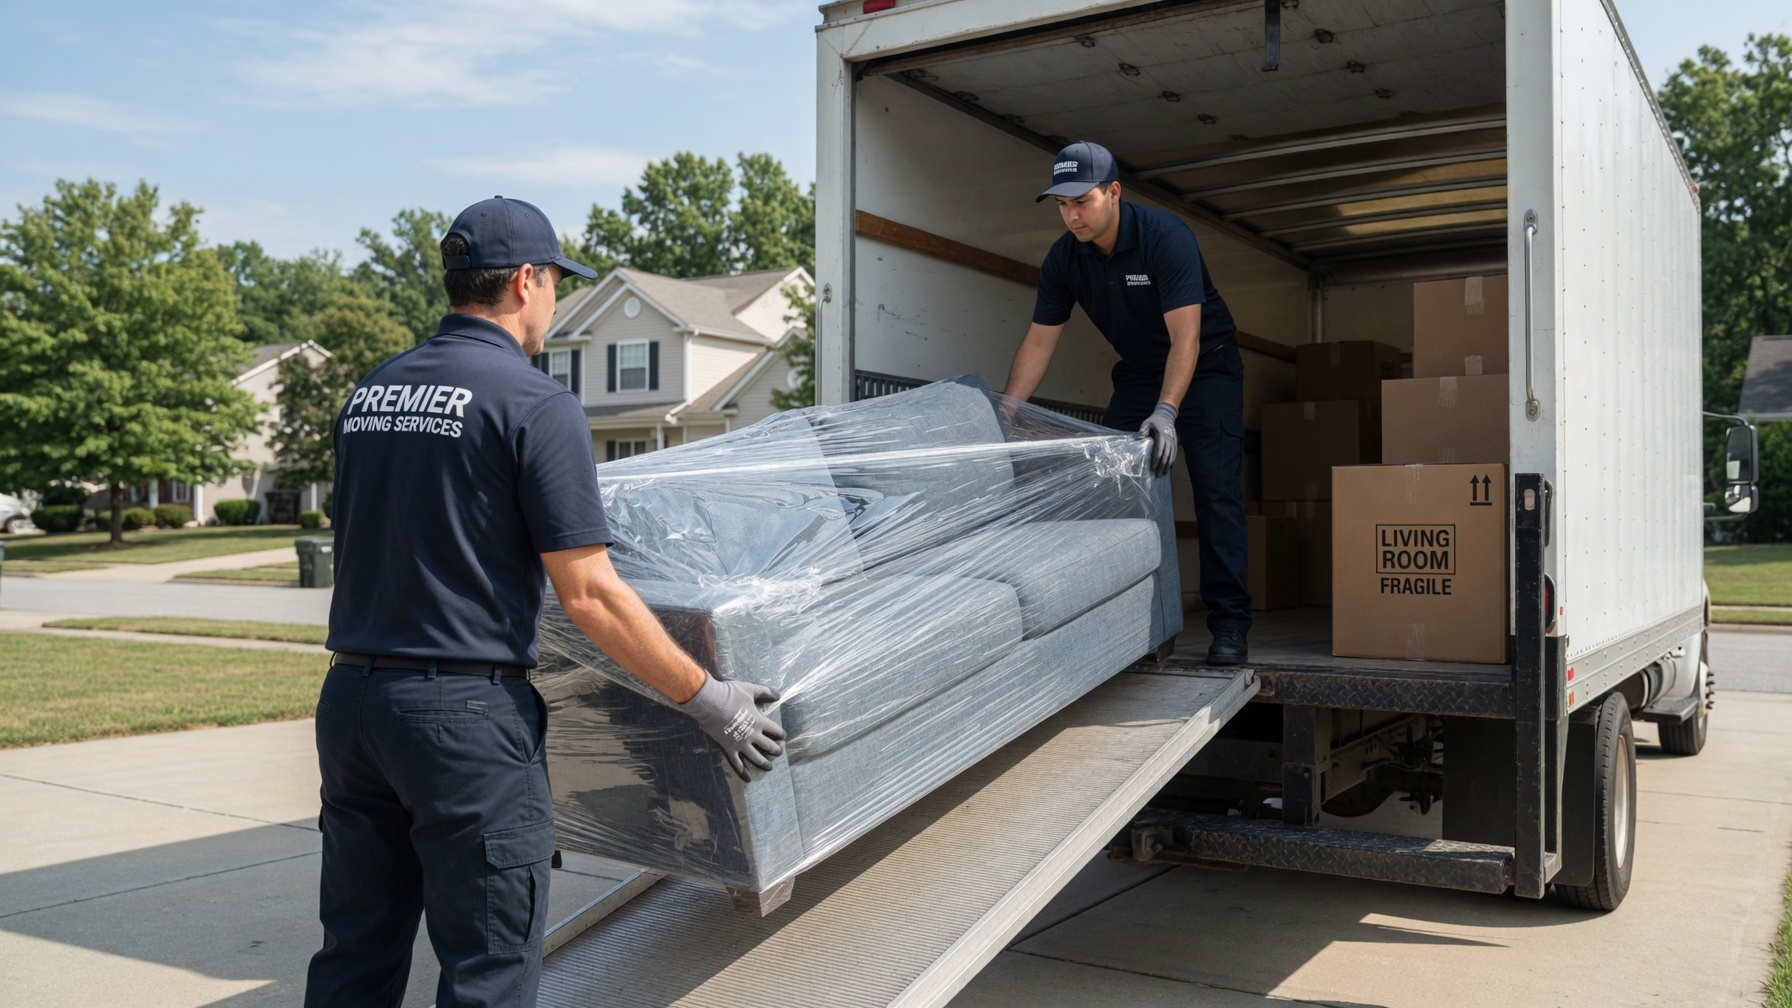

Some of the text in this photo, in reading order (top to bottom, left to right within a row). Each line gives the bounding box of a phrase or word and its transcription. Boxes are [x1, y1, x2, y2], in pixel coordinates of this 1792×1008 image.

[347, 385, 473, 417] PREMIER
[343, 416, 463, 438] MOVING SERVICES
[1381, 529, 1450, 547] LIVING
[1382, 550, 1449, 570] ROOM
[1380, 578, 1452, 595] FRAGILE
